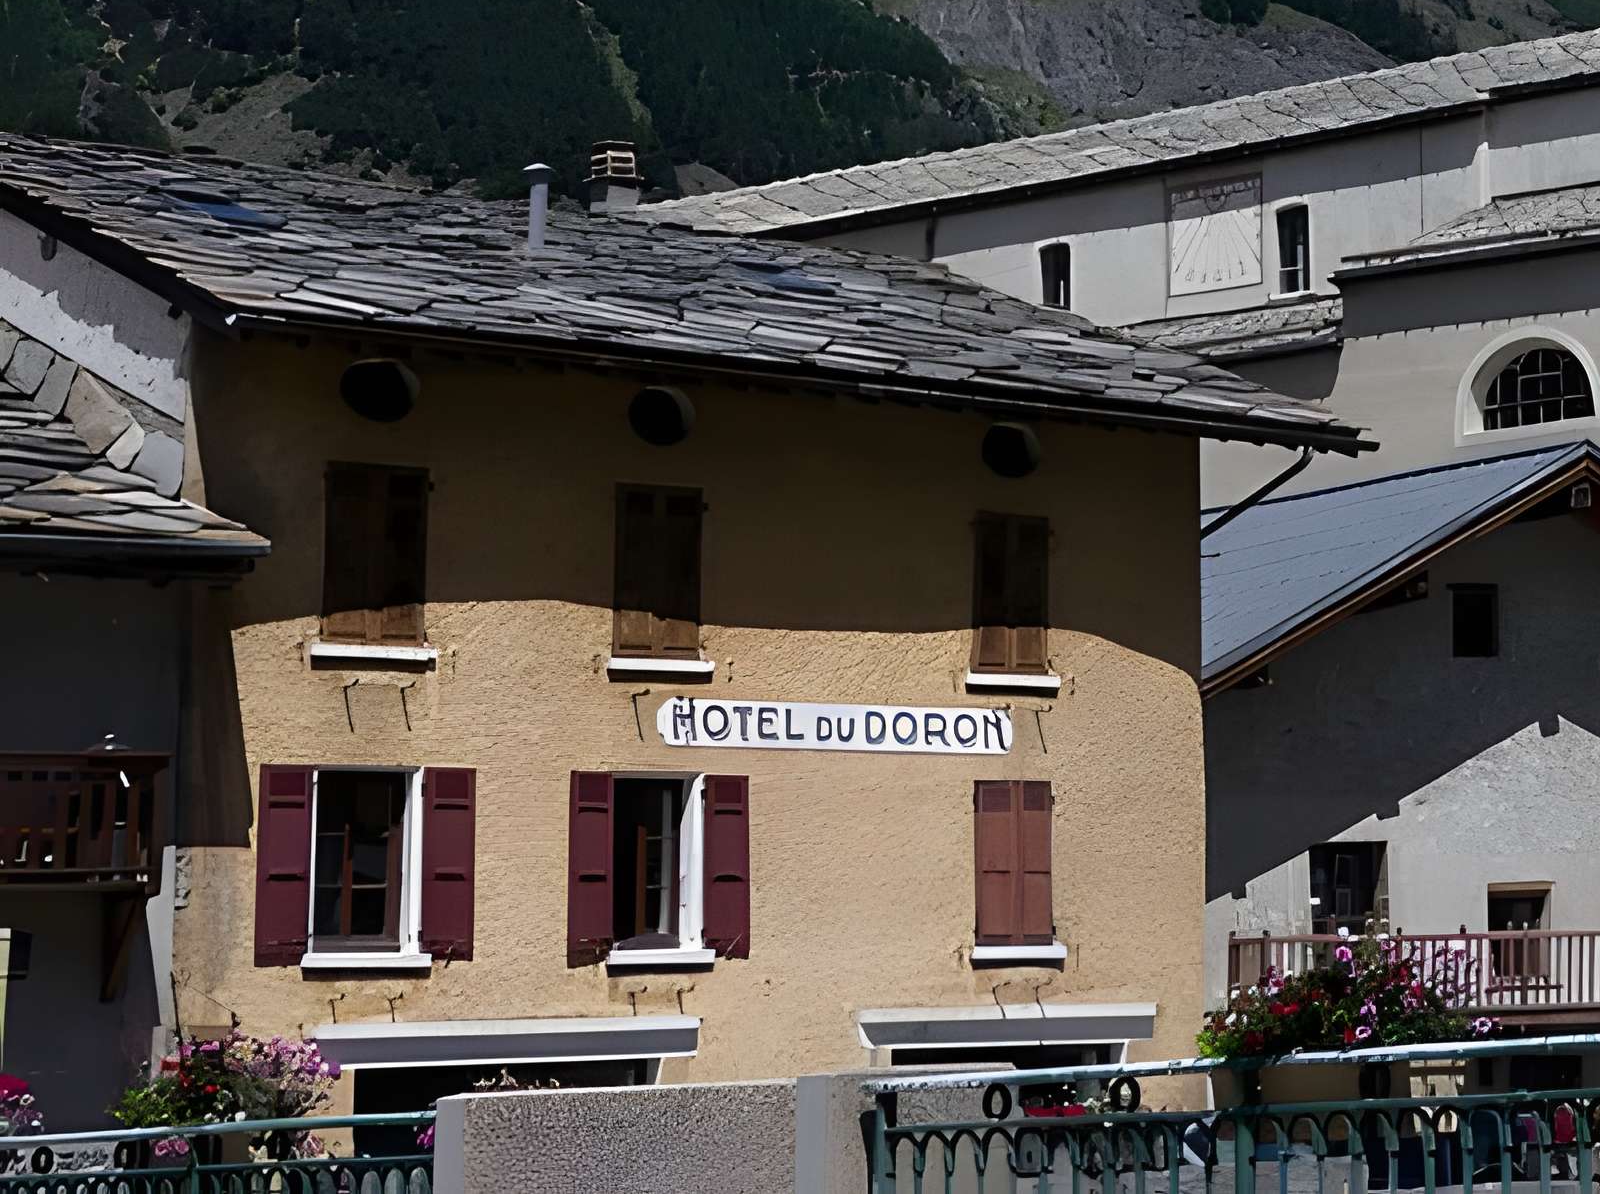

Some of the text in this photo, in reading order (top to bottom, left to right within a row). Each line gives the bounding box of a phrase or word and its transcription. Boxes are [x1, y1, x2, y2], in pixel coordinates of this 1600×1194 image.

[673, 698, 1011, 751] HOTEL DU DORON
